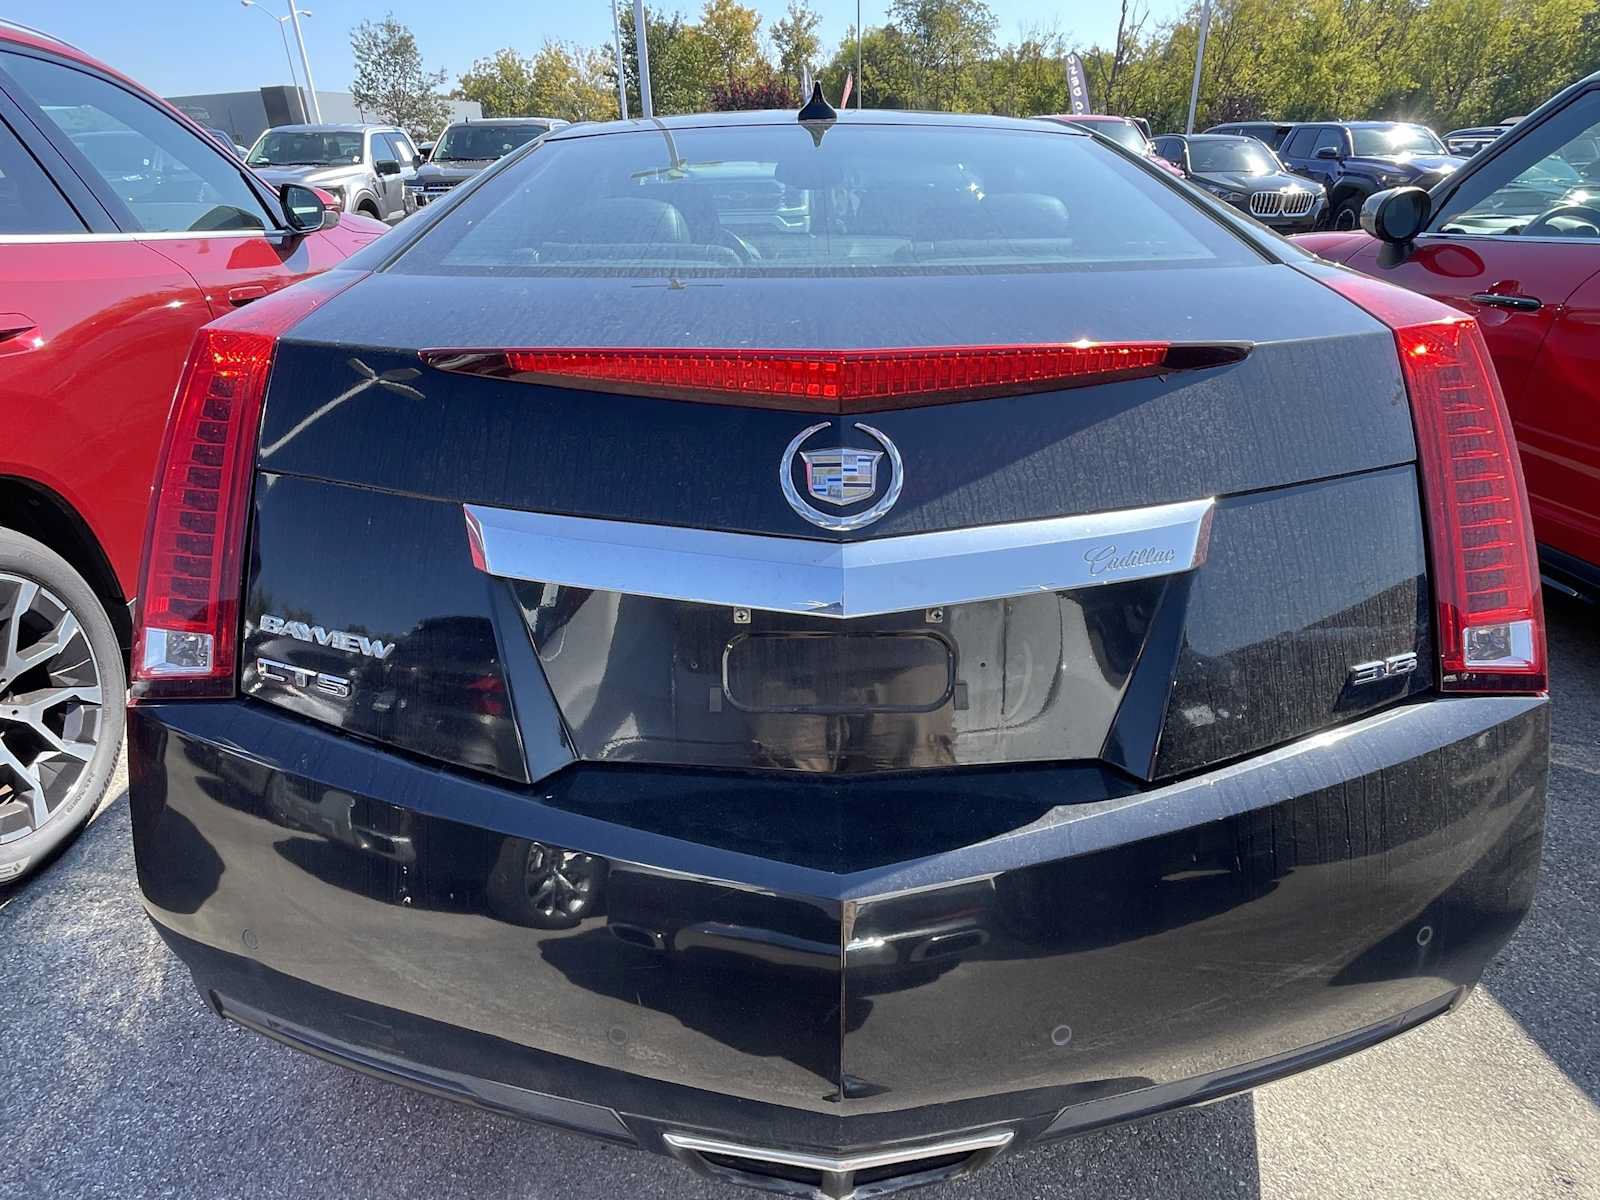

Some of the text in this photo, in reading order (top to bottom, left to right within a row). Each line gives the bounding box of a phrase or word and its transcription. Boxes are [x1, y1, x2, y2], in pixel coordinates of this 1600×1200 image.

[1083, 544, 1175, 576] Cadillac
[259, 613, 396, 659] BAYVIEW
[256, 657, 351, 698] CTS
